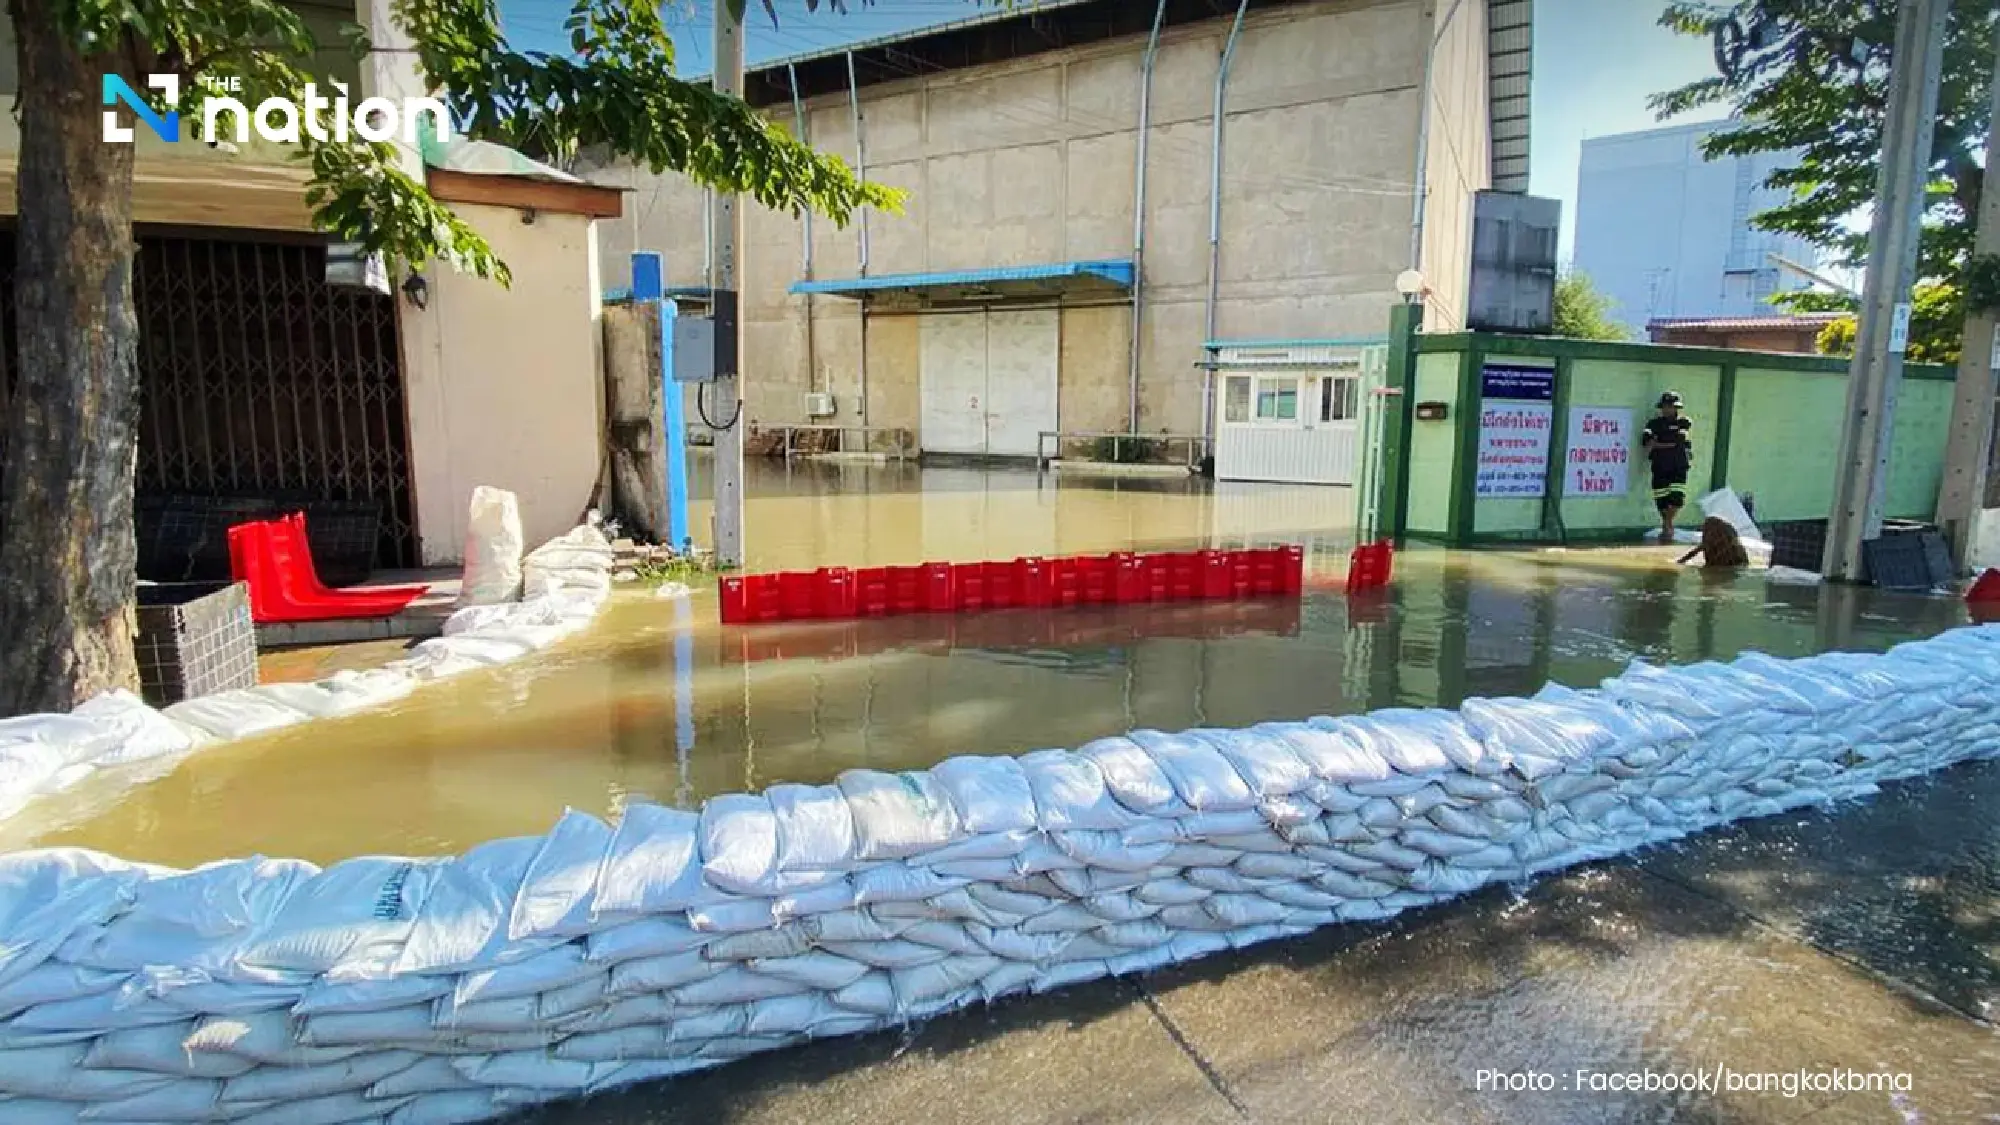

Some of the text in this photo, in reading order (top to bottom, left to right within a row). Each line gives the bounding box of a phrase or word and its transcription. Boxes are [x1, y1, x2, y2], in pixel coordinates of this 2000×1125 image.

[1582, 413, 1618, 434] มีลาน
[1569, 441, 1627, 464] กลางแจ้ง
